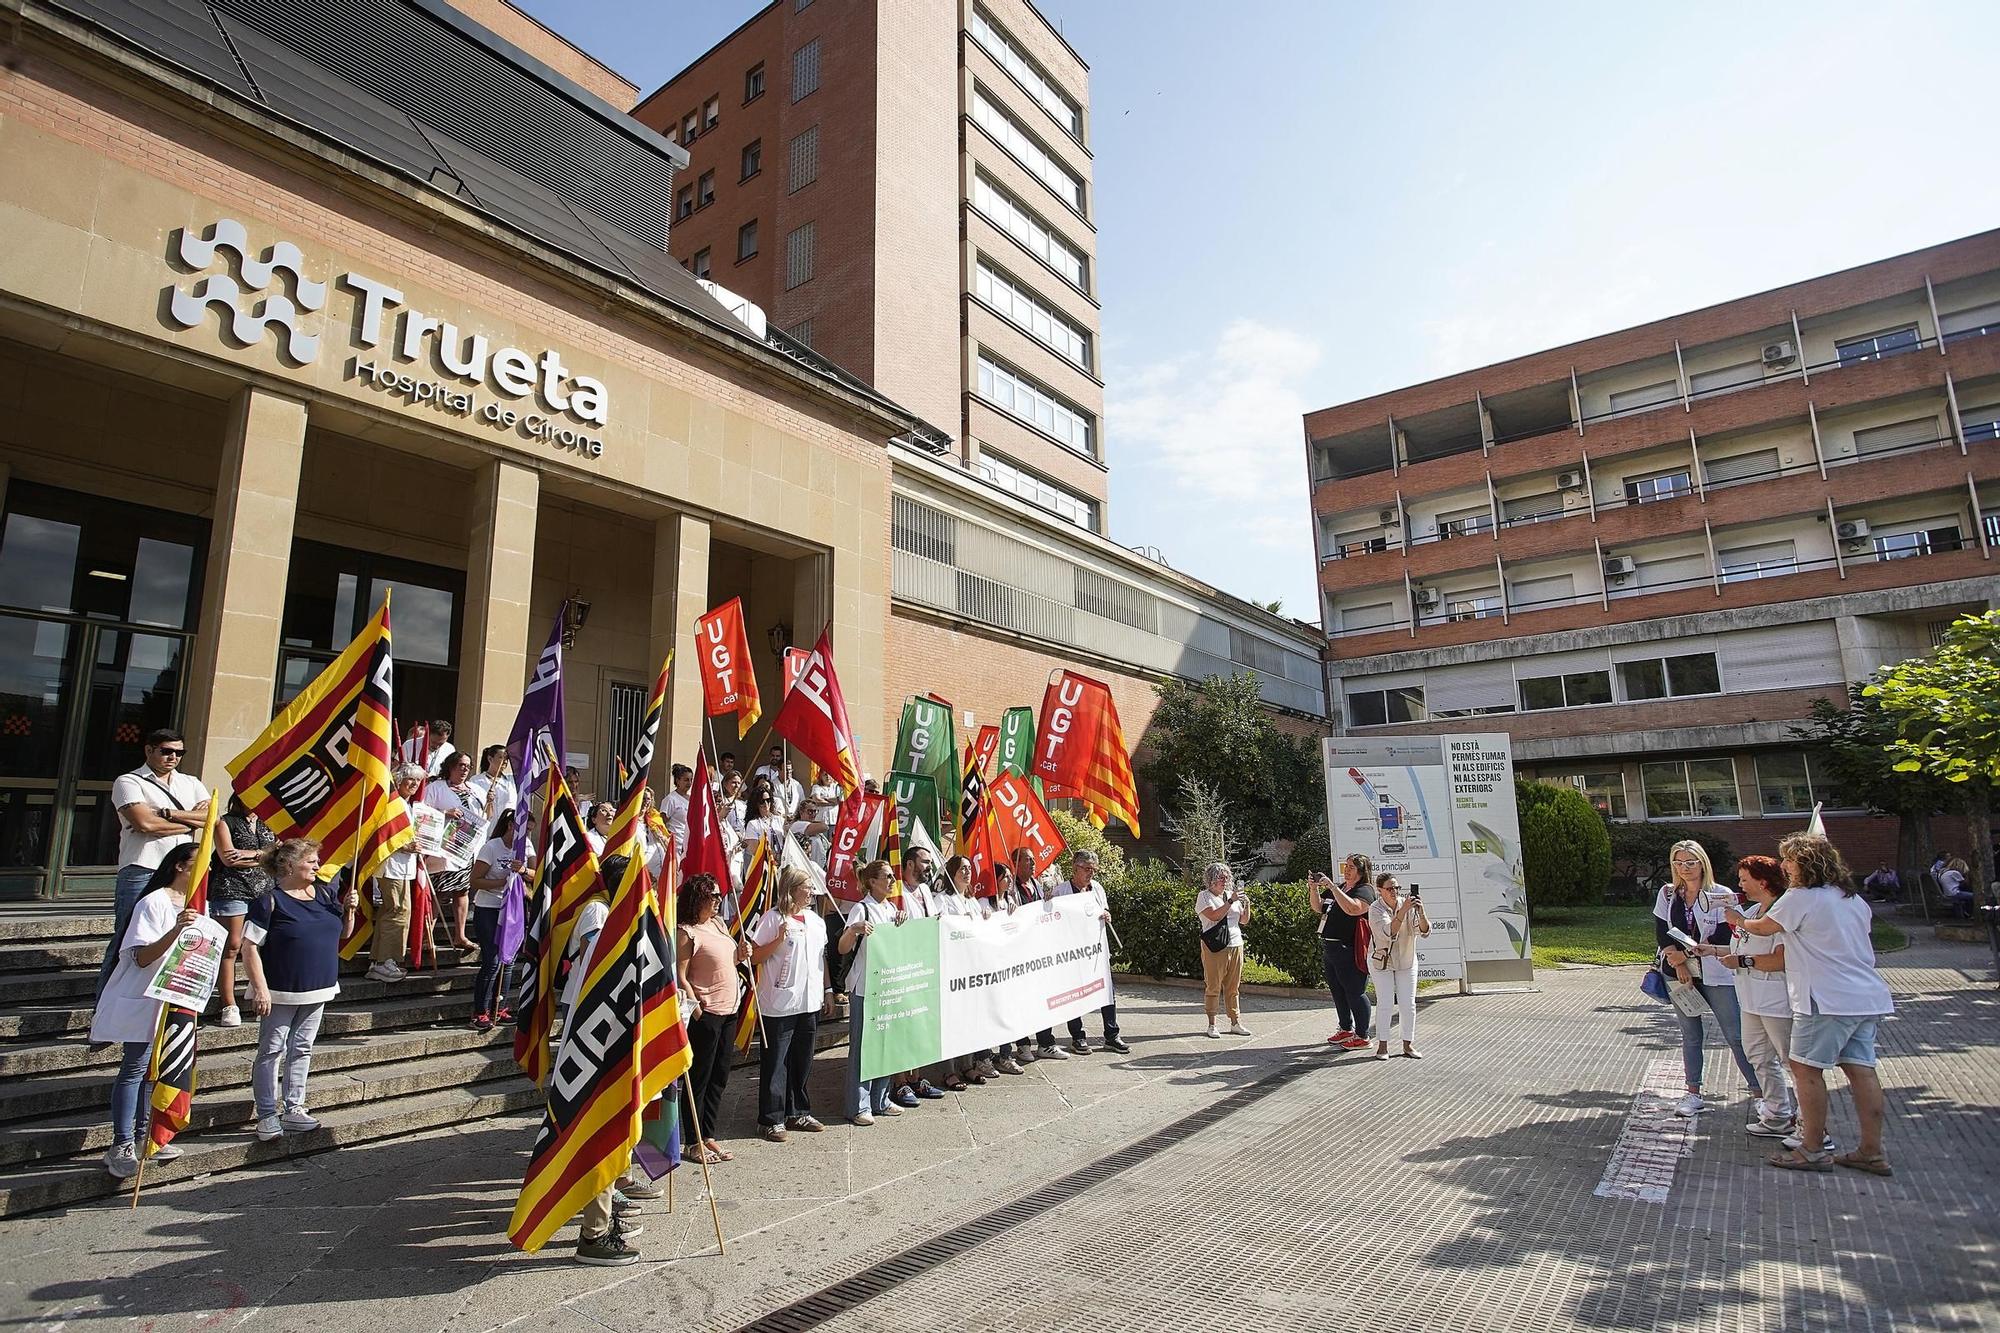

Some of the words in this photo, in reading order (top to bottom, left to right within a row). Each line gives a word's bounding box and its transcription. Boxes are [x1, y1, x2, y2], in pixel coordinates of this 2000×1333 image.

[347, 272, 608, 425] Trueta
[355, 354, 476, 412] Hospital
[484, 401, 517, 425] de
[524, 413, 604, 456] Girona
[707, 618, 733, 693] UGT
[1047, 679, 1084, 759] UGT
[908, 704, 934, 774] UGT
[1451, 742, 1461, 751] NO
[1462, 740, 1480, 751] ESTÀ
[1452, 751, 1481, 761] PERMÈS
[1481, 752, 1506, 760] FUMAR
[1040, 760, 1058, 772] .cat
[1453, 763, 1461, 772] NI
[1462, 763, 1475, 772] ALS
[1476, 762, 1505, 772] EDIFICIS
[1454, 774, 1462, 783] NI
[1463, 773, 1476, 783] ALS
[1477, 773, 1502, 782] ESPAIS
[1047, 784, 1061, 793] .cat
[1455, 784, 1493, 793] EXTERIORS
[1381, 861, 1410, 872] principal
[950, 977, 966, 992] UN
[969, 968, 1011, 988] ESTATUT
[1011, 963, 1025, 978] PER
[1025, 955, 1054, 973] PODER
[1055, 943, 1103, 965] AVANÇAR
